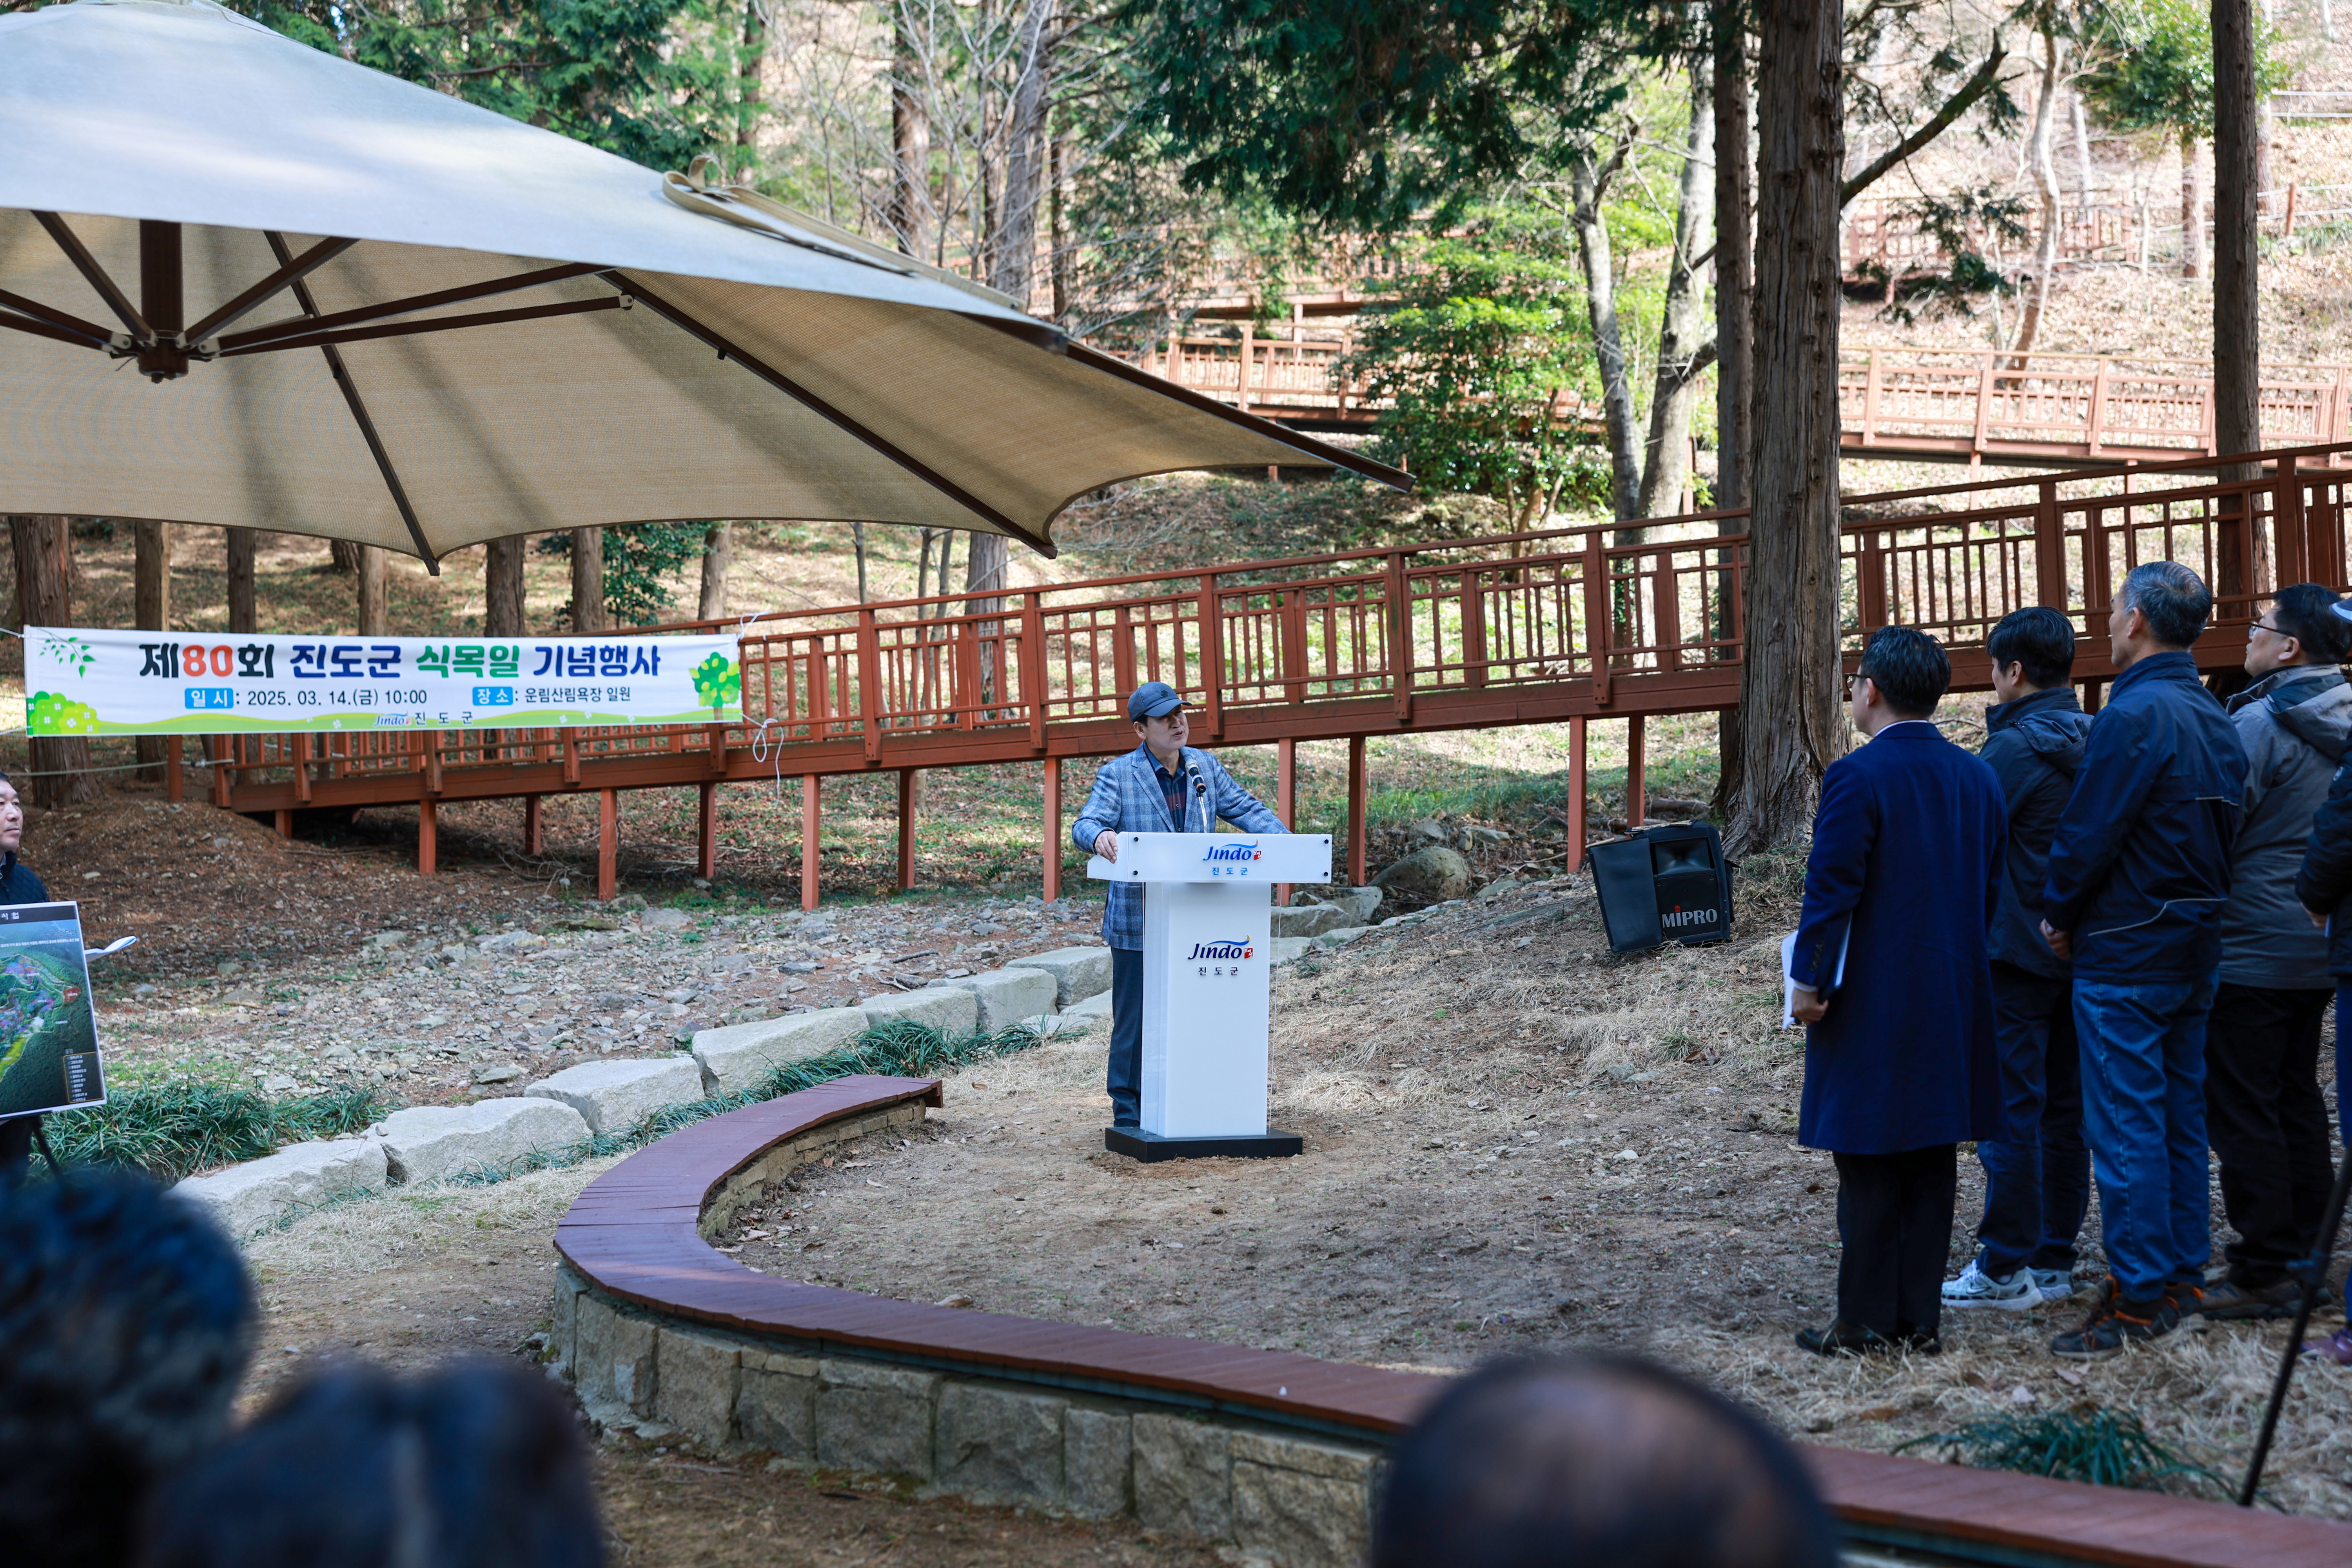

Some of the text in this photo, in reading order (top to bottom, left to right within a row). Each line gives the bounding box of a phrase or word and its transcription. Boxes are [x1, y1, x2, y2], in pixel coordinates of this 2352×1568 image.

[139, 643, 661, 678] 제80회 진도군 식목일 기념행사
[248, 691, 291, 706] 2025.
[298, 691, 321, 705] 03.
[385, 690, 427, 704] 10:00
[525, 687, 602, 702] 운림산림욕장
[607, 686, 630, 701] 일원
[374, 715, 404, 726] Jindo
[1203, 846, 1252, 861] Jindo
[1662, 905, 1717, 928] MIPRO
[1187, 943, 1242, 960] Jindo
